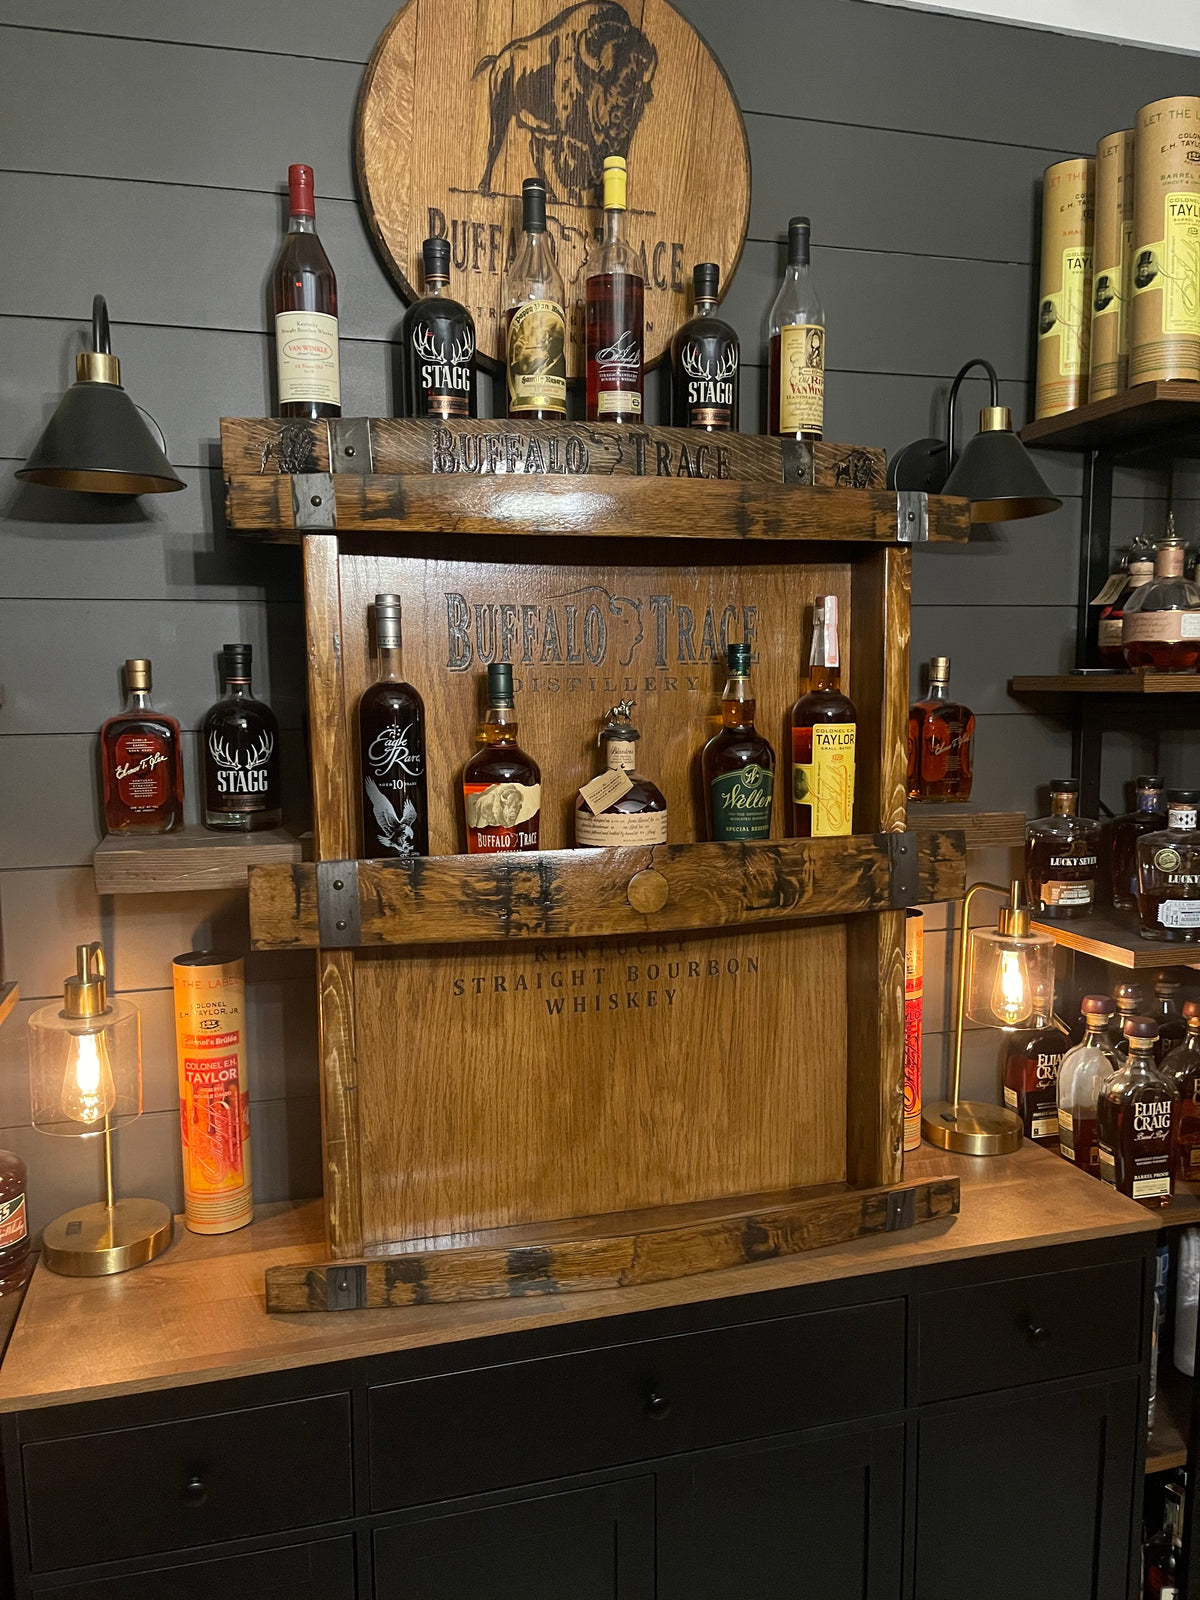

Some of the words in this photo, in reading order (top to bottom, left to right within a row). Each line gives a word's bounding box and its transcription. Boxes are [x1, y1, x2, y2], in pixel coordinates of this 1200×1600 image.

[1169, 109, 1191, 119] THE
[1103, 144, 1119, 158] LET
[1067, 171, 1087, 182] THE
[1161, 172, 1194, 181] BARREL
[303, 345, 328, 353] WINKLE
[422, 365, 470, 391] STAGG
[688, 381, 733, 405] STAGG
[790, 383, 807, 394] VAN
[432, 427, 590, 474] BUFFALO
[629, 433, 729, 480] TRACE
[445, 592, 608, 672] BUFFALO
[650, 595, 760, 671] TRACE
[513, 676, 700, 693] DISTILLERY
[369, 723, 413, 766] Eagle
[816, 733, 854, 745] TAYLOR
[372, 746, 424, 776] Rare
[217, 769, 268, 792] STAGG
[392, 779, 404, 790] 10
[721, 784, 772, 809] Weller
[477, 832, 511, 848] BUFFALO
[1050, 857, 1079, 866] LUCKY
[1168, 874, 1198, 884] LUCKY
[1170, 915, 1178, 925] 14
[533, 936, 686, 963] KENTUCKY
[453, 967, 607, 996] STRAIGHT
[626, 956, 760, 983] BOURBON
[182, 980, 202, 990] THE
[192, 1001, 227, 1010] OLONEL
[546, 988, 677, 1016] WHISKEY
[185, 1061, 223, 1071] COLONEL
[186, 1068, 238, 1084] TAYLOR
[1134, 1101, 1172, 1117] ELIJAH
[1133, 1114, 1170, 1132] CRAIG
